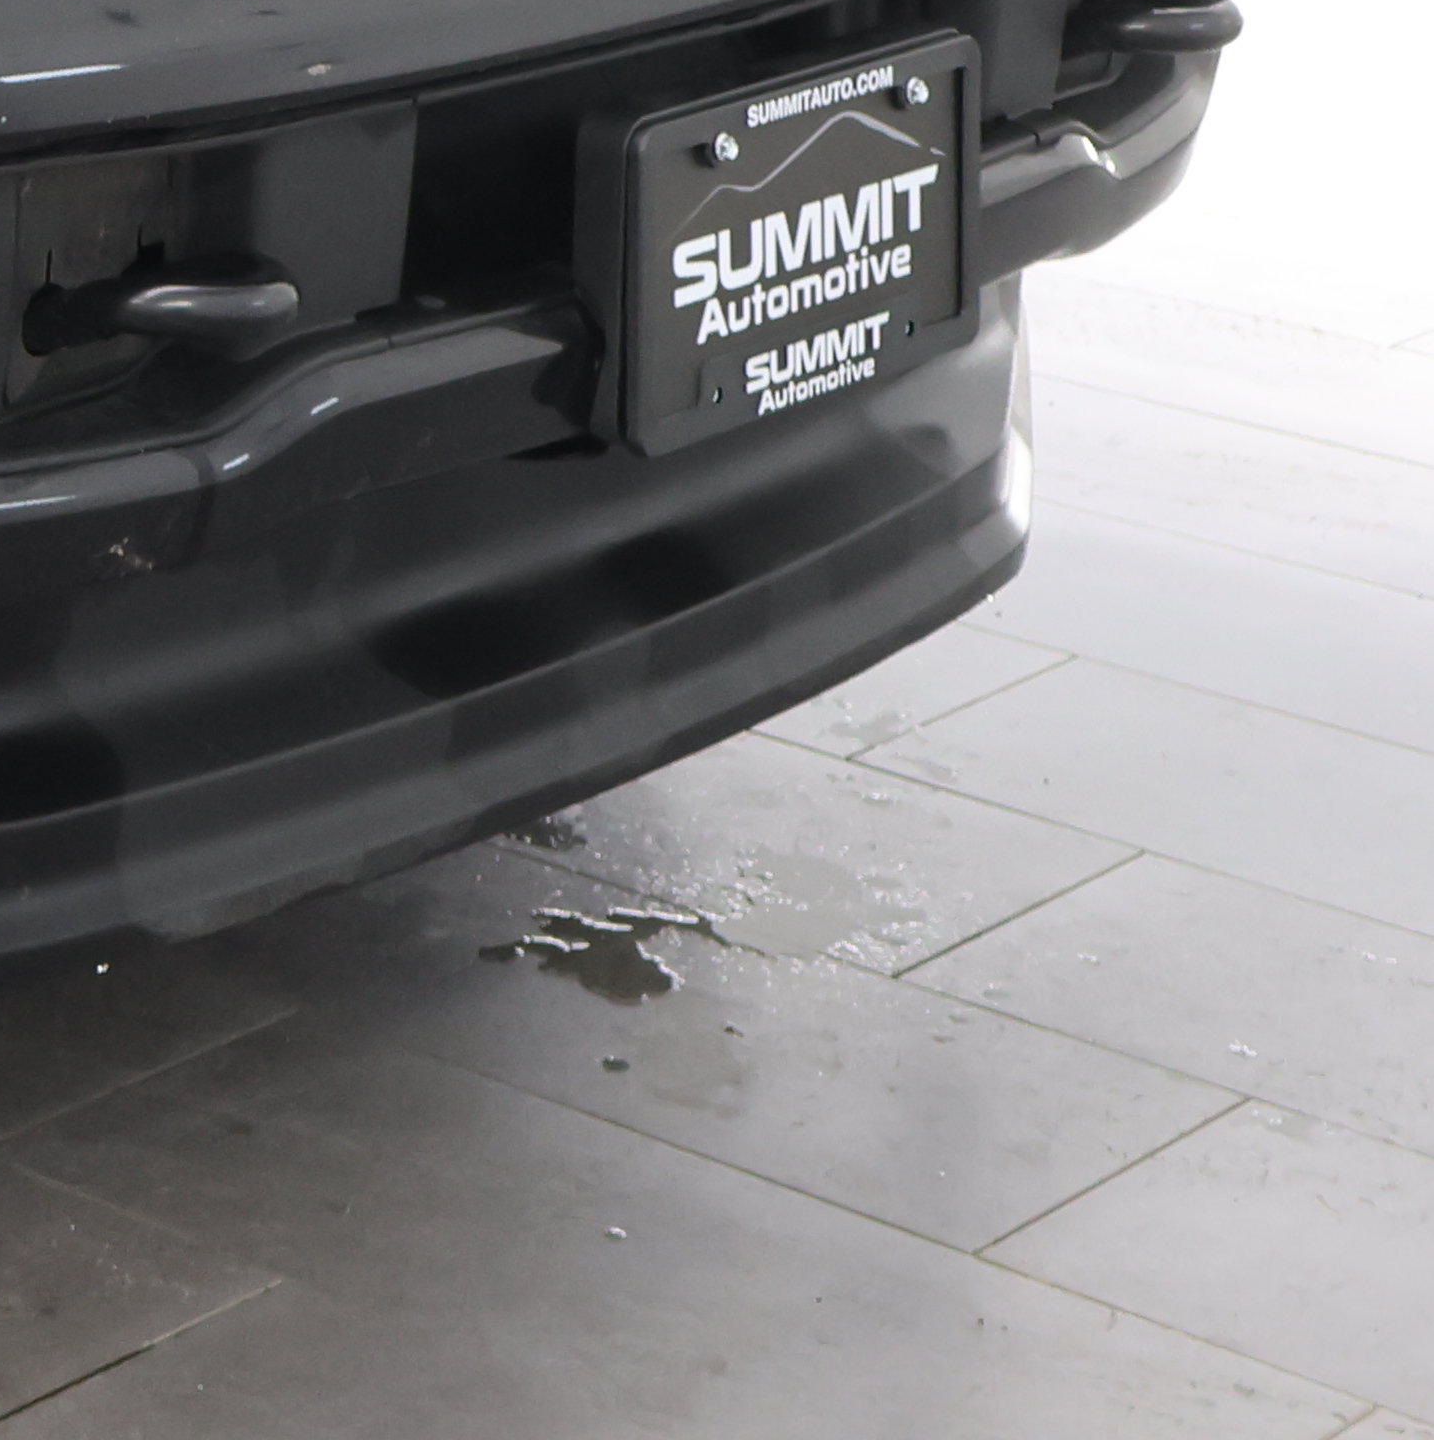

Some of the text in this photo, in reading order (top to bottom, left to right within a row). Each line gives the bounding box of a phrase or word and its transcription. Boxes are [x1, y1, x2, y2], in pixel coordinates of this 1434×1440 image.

[746, 64, 894, 129] SUMMITAUTO.COM
[671, 163, 939, 309] SUMMIT
[696, 244, 912, 346] Automotive
[744, 311, 890, 394] SUMMIT
[757, 356, 876, 417] Automotive
